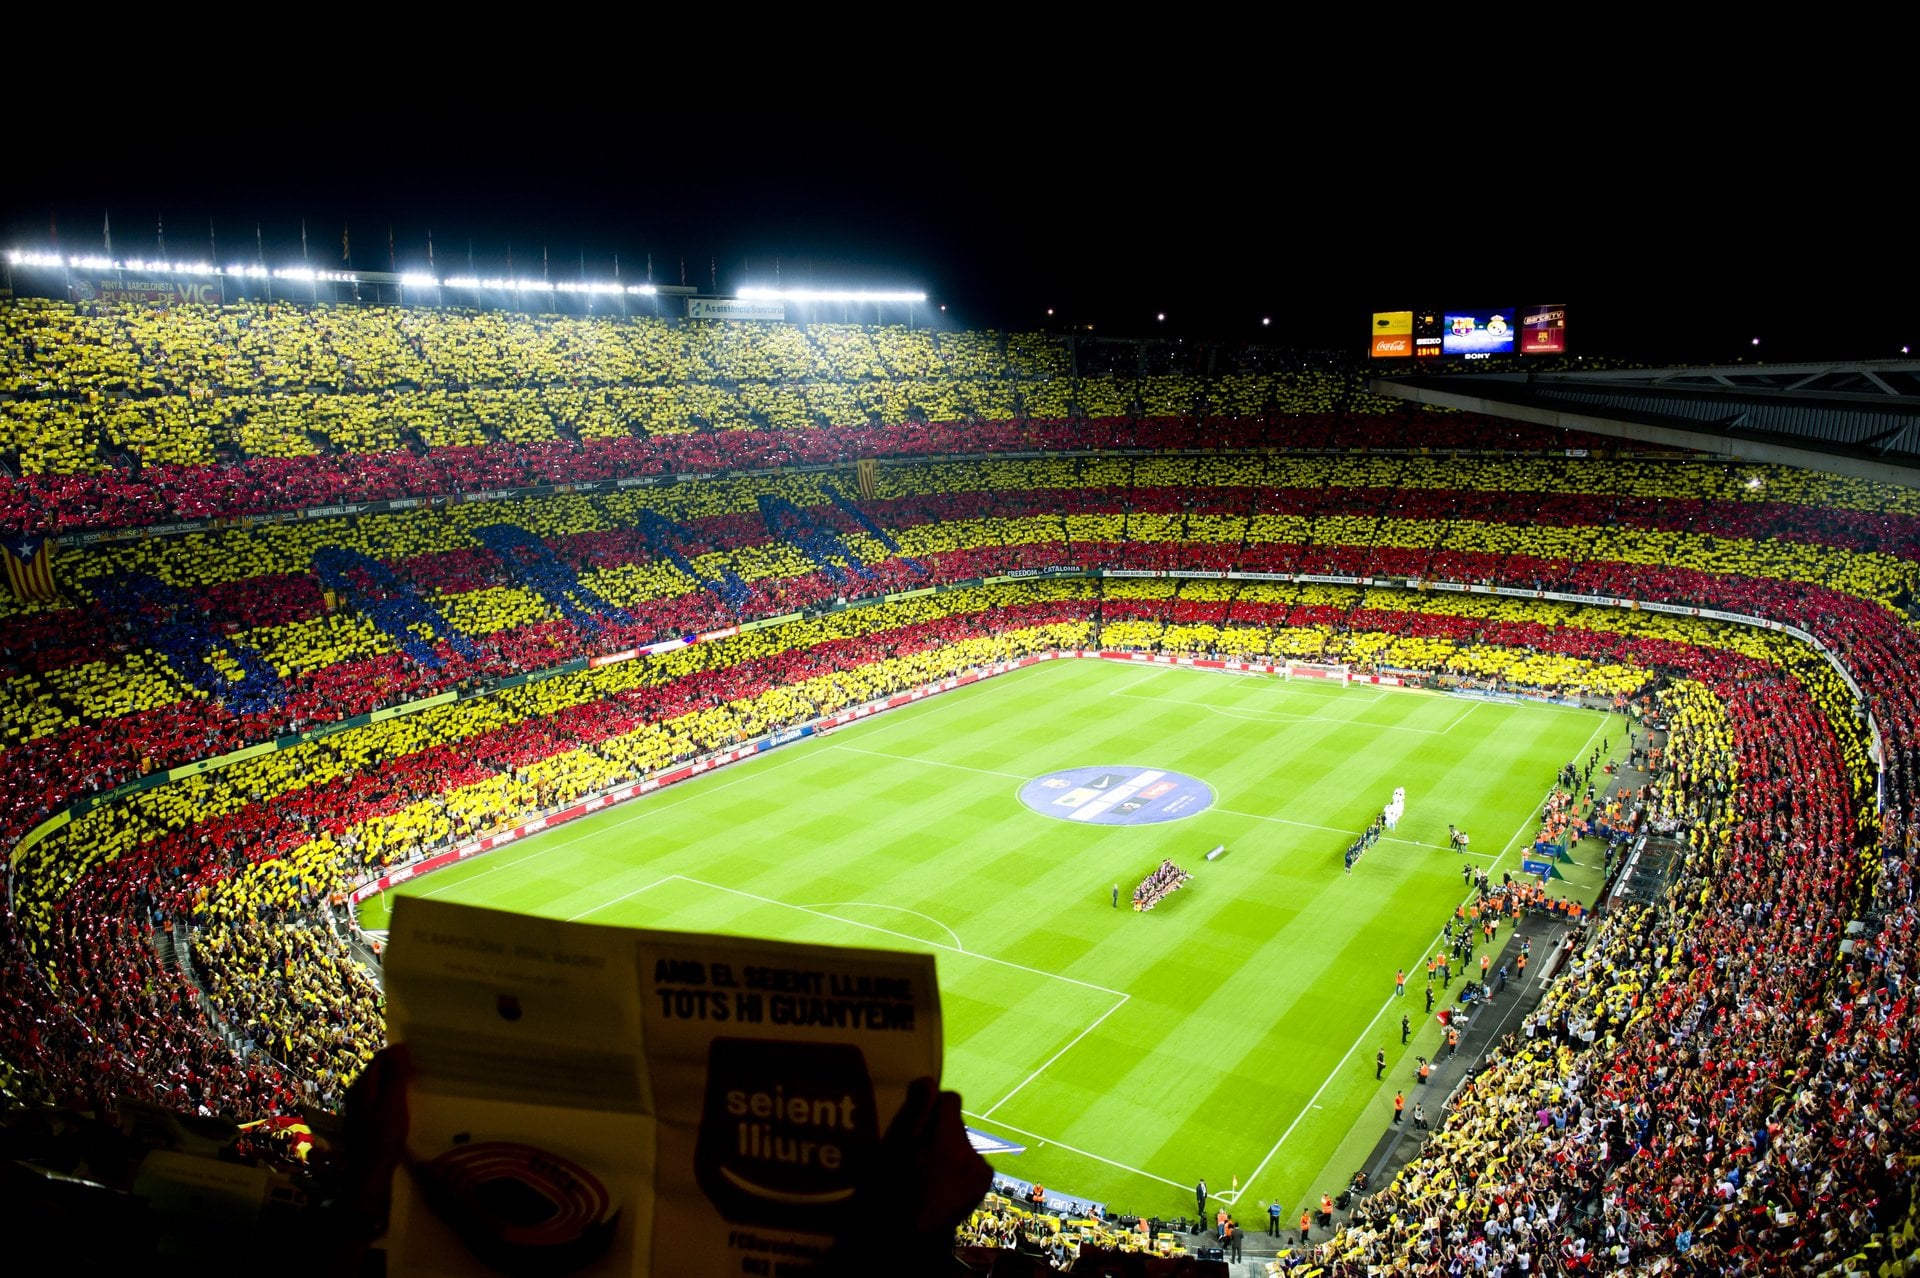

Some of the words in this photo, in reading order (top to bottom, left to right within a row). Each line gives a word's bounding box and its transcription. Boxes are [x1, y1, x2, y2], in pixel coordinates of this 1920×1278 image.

[177, 283, 214, 304] VIC
[307, 505, 357, 518] NIKEFOOTBALL.COM
[1007, 569, 1038, 577] FREEDOM
[1043, 565, 1080, 574] CATALONIA
[1661, 605, 1688, 614] AIRLINES
[1714, 612, 1740, 620] TURKISH
[655, 959, 705, 985] AMB
[711, 962, 739, 988] EL
[743, 965, 825, 995] SEIENT
[830, 974, 913, 1001] LLIURE
[656, 989, 730, 1021] TOTS
[736, 993, 763, 1023] HI
[770, 995, 915, 1030] GUANYEM!
[725, 1083, 857, 1130] seient
[737, 1122, 843, 1170] lliure
